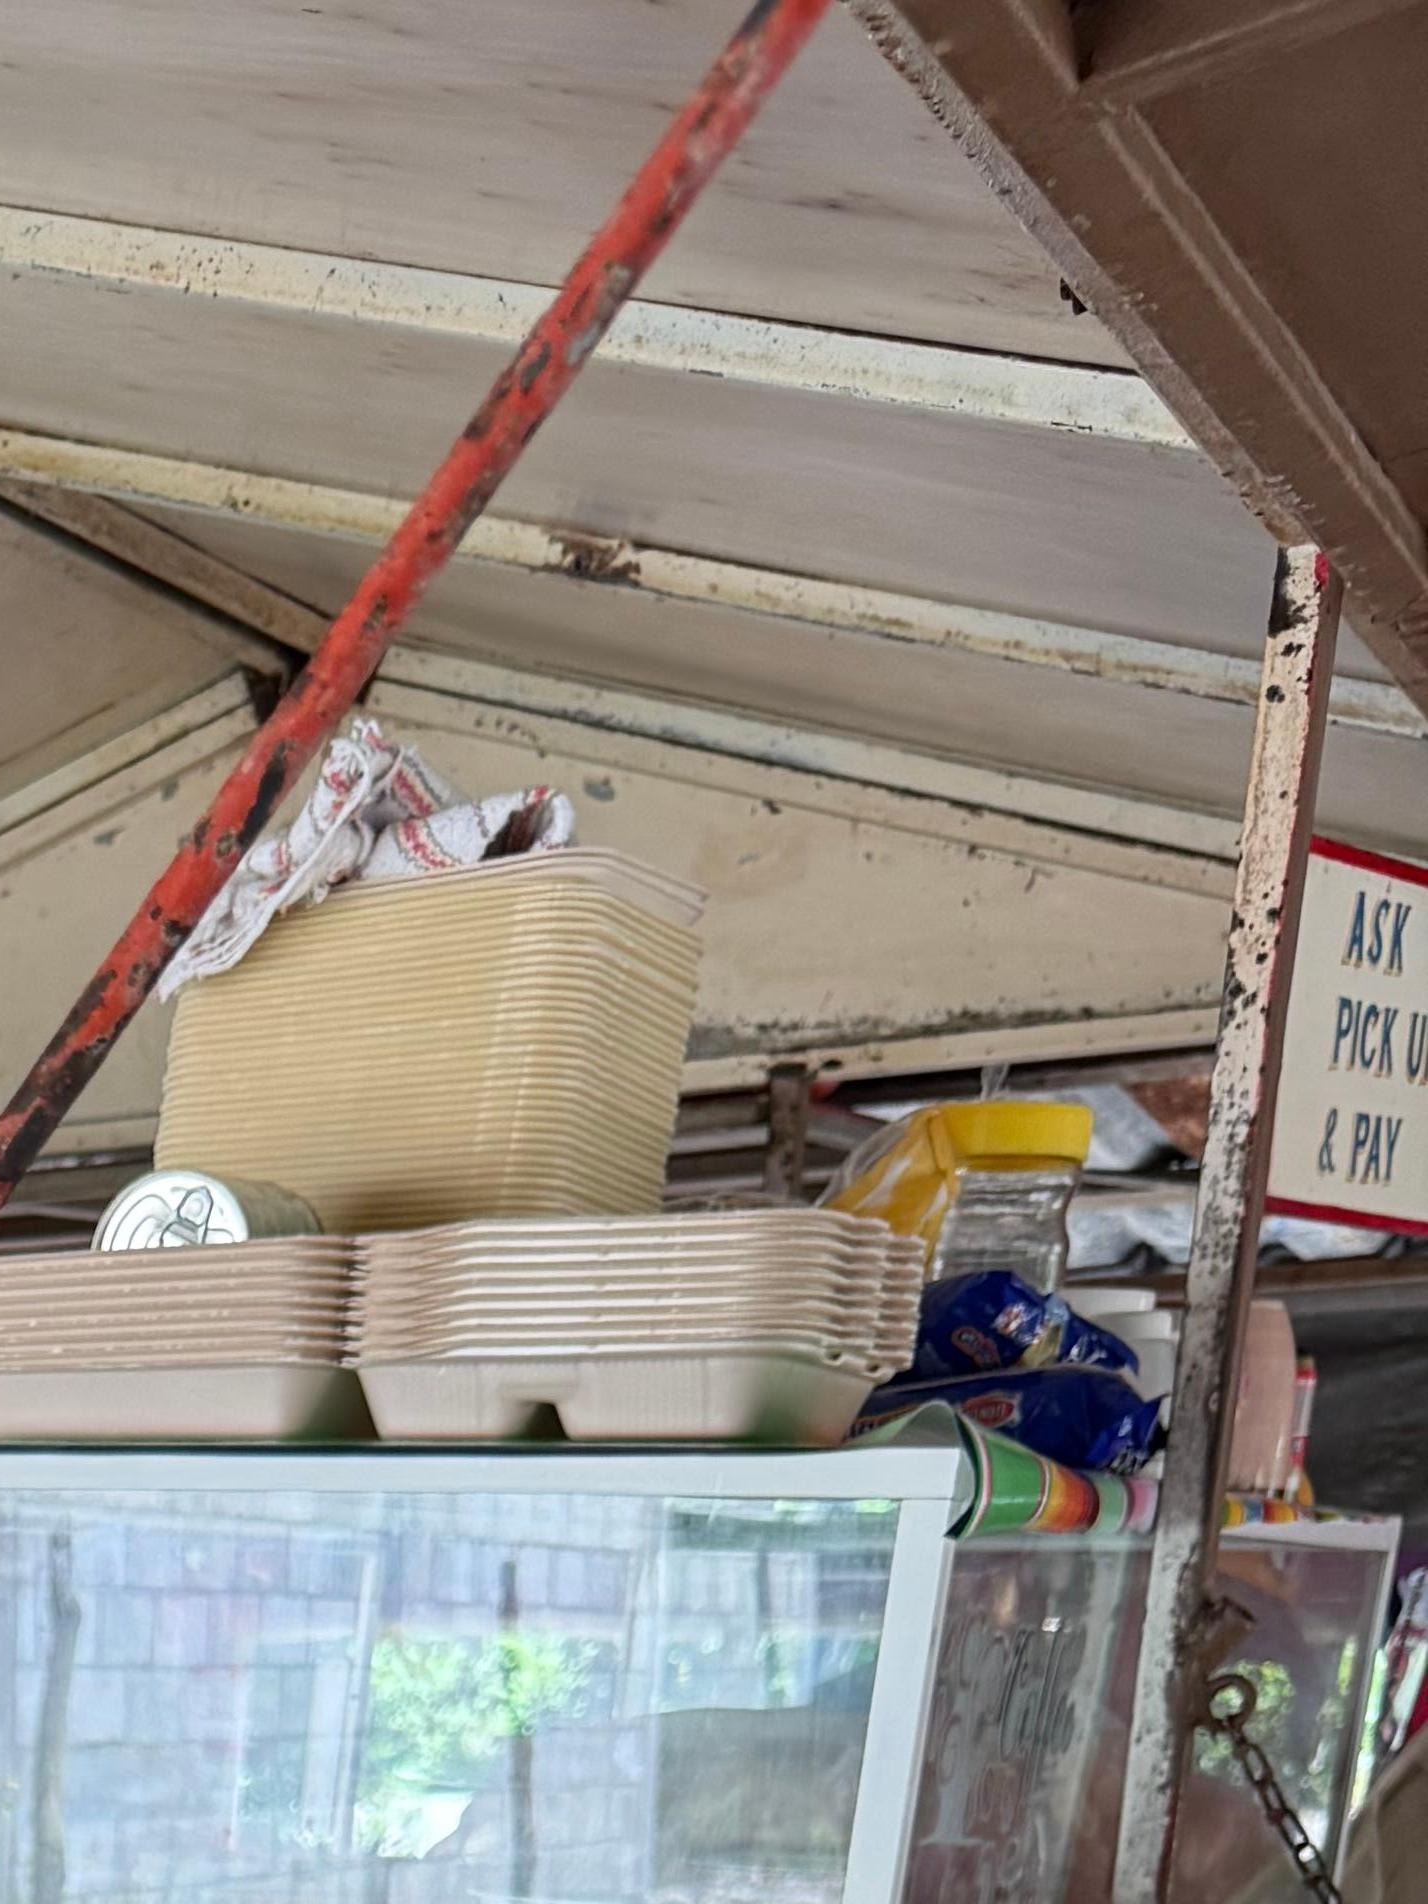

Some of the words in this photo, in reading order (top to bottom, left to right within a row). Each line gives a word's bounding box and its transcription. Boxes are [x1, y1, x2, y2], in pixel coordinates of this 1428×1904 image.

[1341, 890, 1411, 976] ASK
[1328, 996, 1399, 1078] PICK
[1318, 1107, 1338, 1176] &
[1345, 1112, 1403, 1186] PAY
